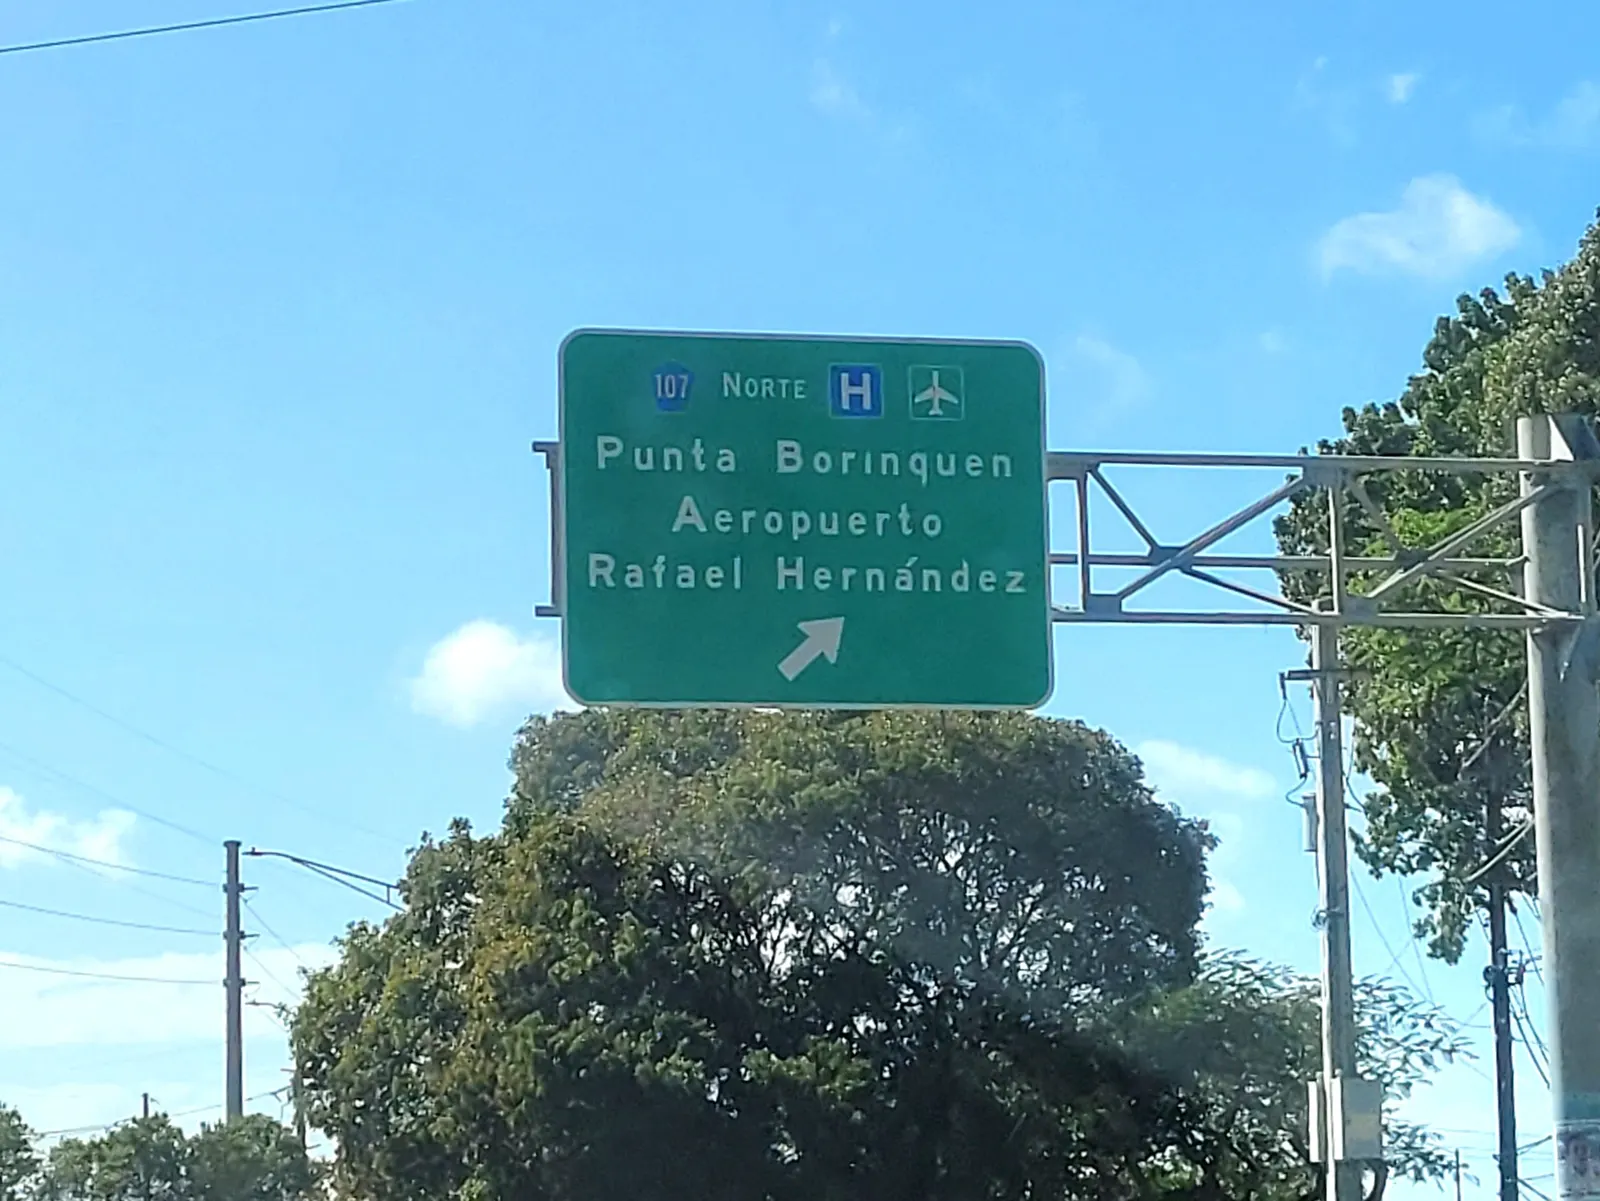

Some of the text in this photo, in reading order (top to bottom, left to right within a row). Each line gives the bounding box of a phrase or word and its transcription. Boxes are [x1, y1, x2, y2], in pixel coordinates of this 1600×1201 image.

[655, 372, 872, 410] 107 NORTE H
[597, 435, 1012, 485] Punta Borinquen
[671, 495, 942, 540] Aeropuerto
[588, 553, 1026, 593] Rafael Hernández
